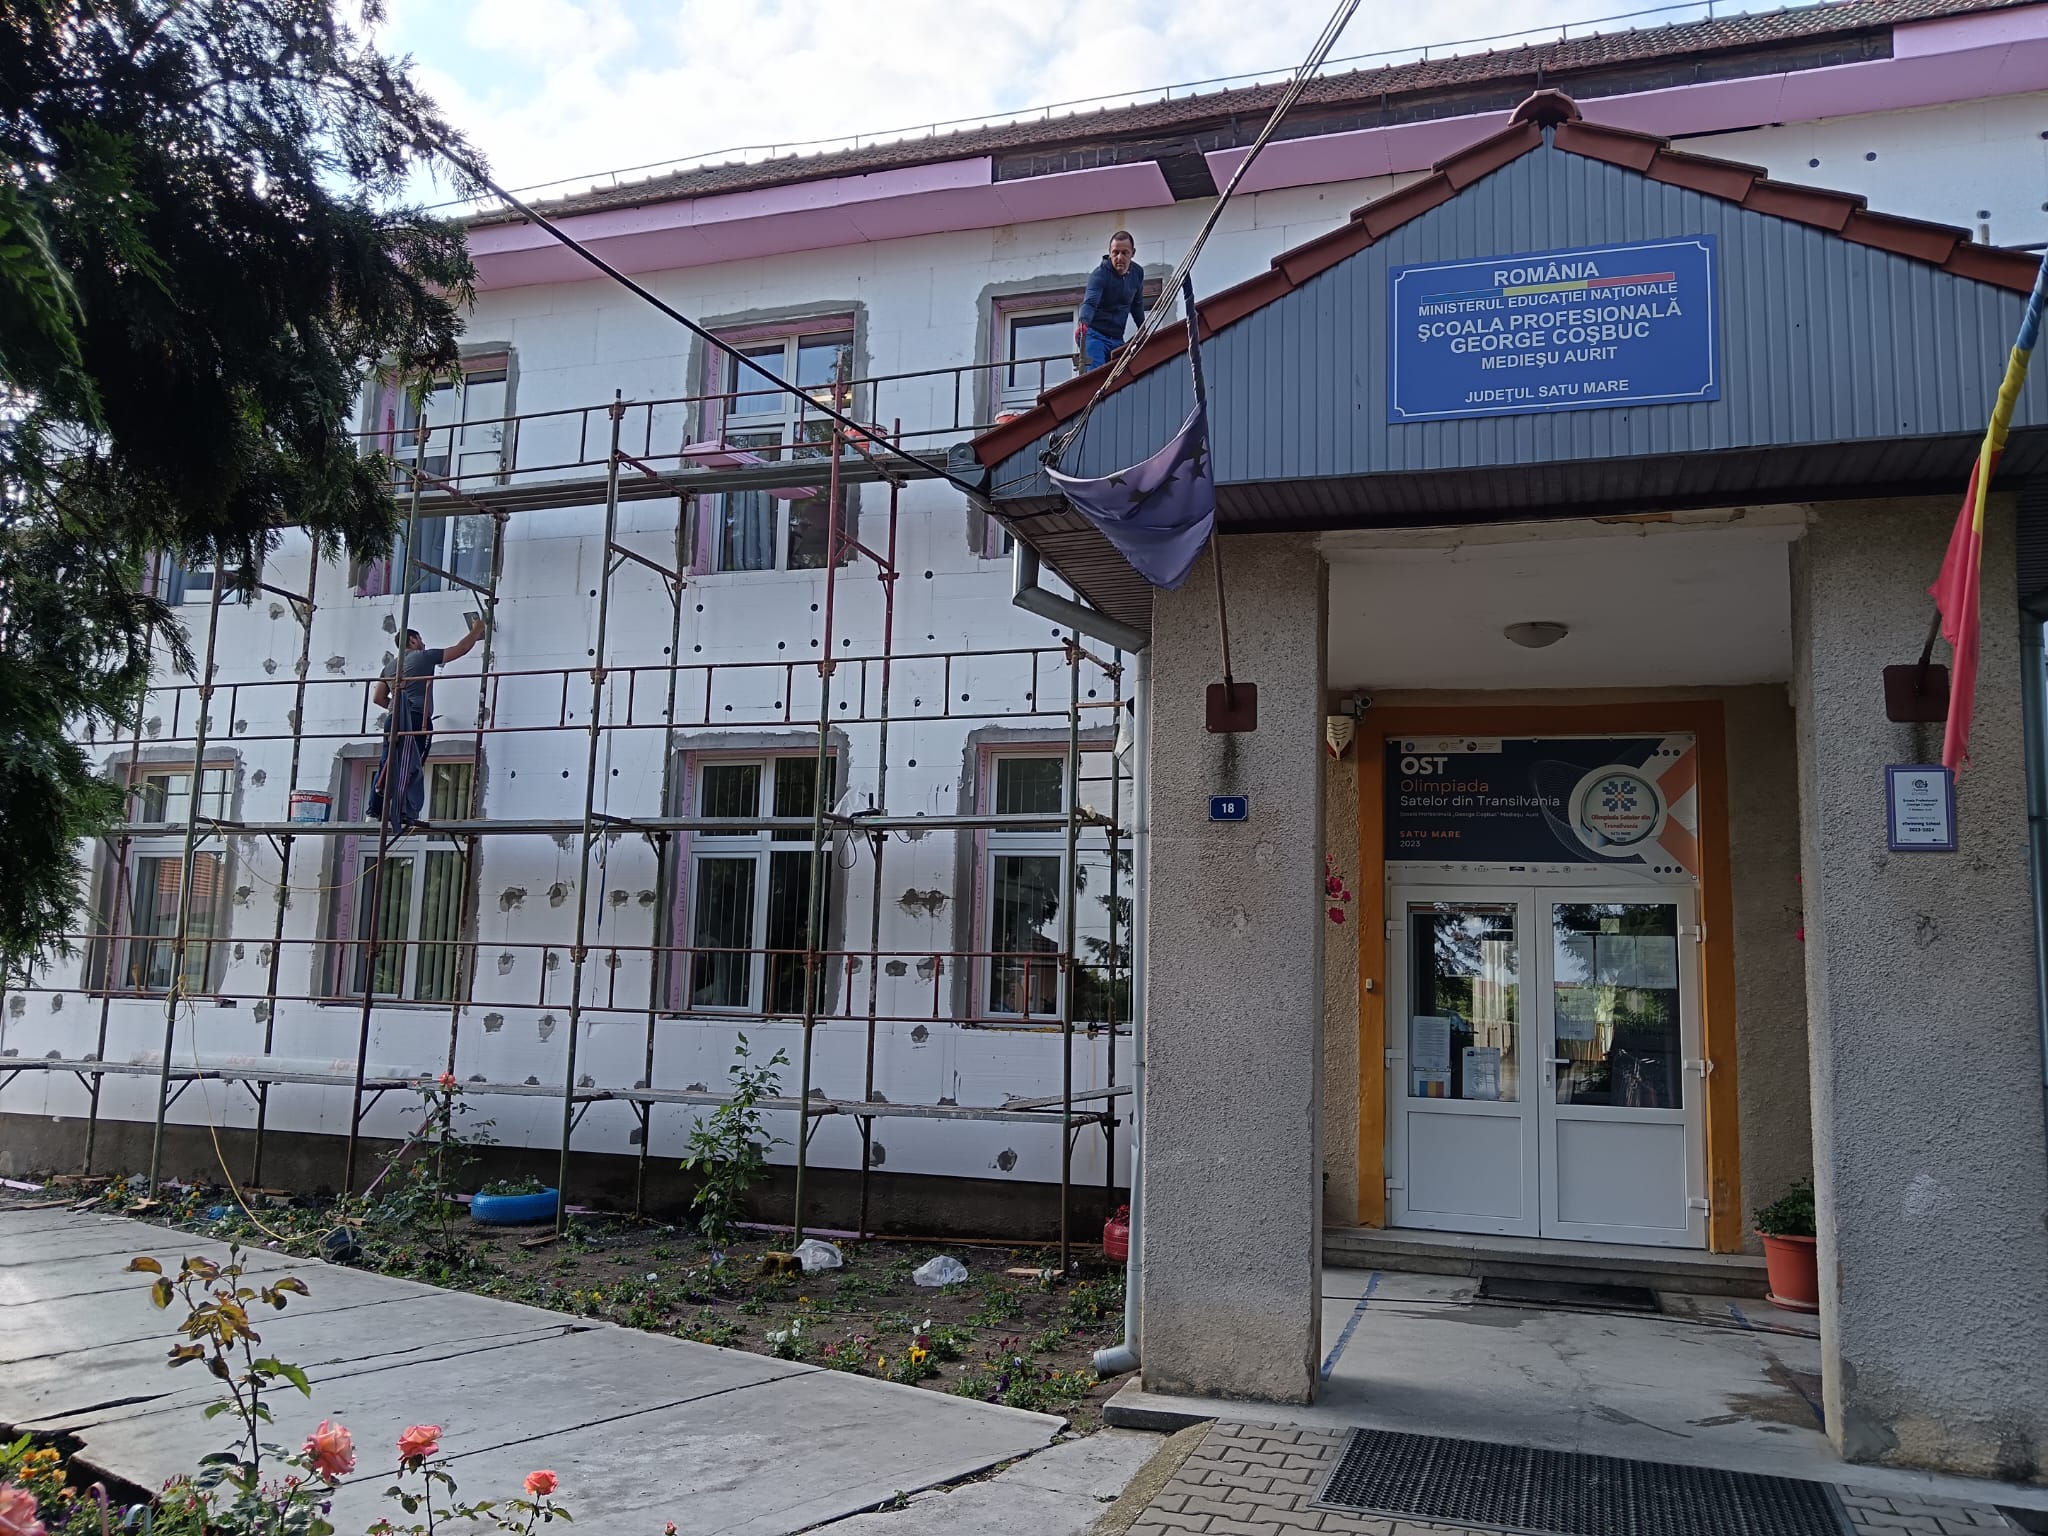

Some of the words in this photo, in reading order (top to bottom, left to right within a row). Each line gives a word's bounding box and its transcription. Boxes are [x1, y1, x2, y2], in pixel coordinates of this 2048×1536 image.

[1493, 261, 1600, 286] ROMÂNIA
[1418, 298, 1504, 317] MINISTERUL
[1510, 297, 1682, 330] PROFESIONALĂ
[1450, 330, 1546, 354] GEORGE
[1564, 346, 1618, 365] AURIT
[1538, 382, 1579, 398] SATU
[1583, 379, 1629, 395] MARE
[1400, 756, 1449, 775] OST
[1400, 776, 1489, 795] Olimpiada
[1221, 803, 1235, 813] 18
[1400, 795, 1449, 807] Satelor
[1452, 795, 1473, 807] din
[1478, 795, 1560, 807] Transilvania
[1399, 830, 1427, 838] SATU
